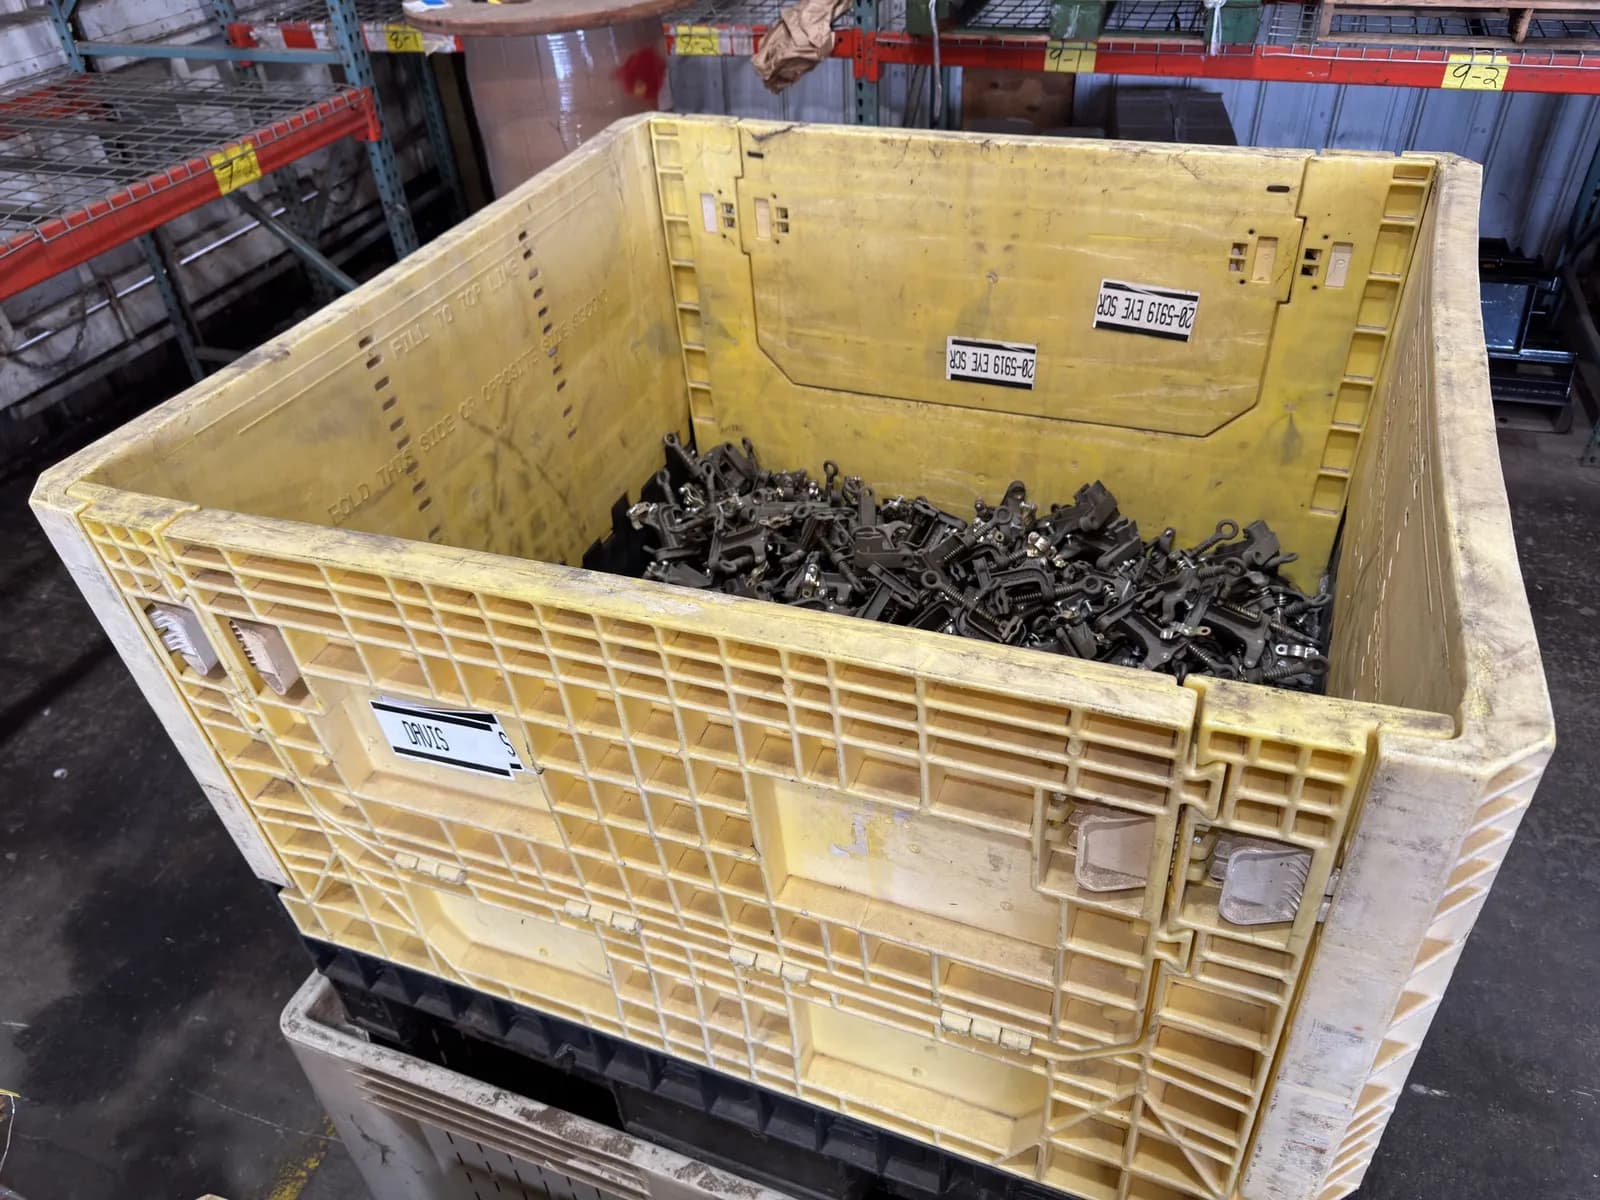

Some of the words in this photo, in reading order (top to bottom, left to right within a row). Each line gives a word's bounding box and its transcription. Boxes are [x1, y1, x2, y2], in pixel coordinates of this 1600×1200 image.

[389, 31, 419, 49] 8-1
[1049, 47, 1082, 72] 9-1
[1452, 63, 1500, 88] 9-2
[389, 323, 430, 360] FILL
[433, 304, 454, 328] TO
[456, 282, 481, 312] TOP
[486, 257, 520, 291] LINE
[1097, 294, 1118, 317] SCR
[1121, 298, 1144, 321] EYE
[1146, 302, 1195, 329] 20-5919
[949, 349, 967, 371] SCR
[971, 352, 989, 373] EYE
[993, 355, 1035, 378] 20-5919
[328, 483, 370, 526] FOLD
[419, 414, 456, 453] SIDE
[402, 720, 450, 752] DAVIS
[498, 731, 516, 756] S
